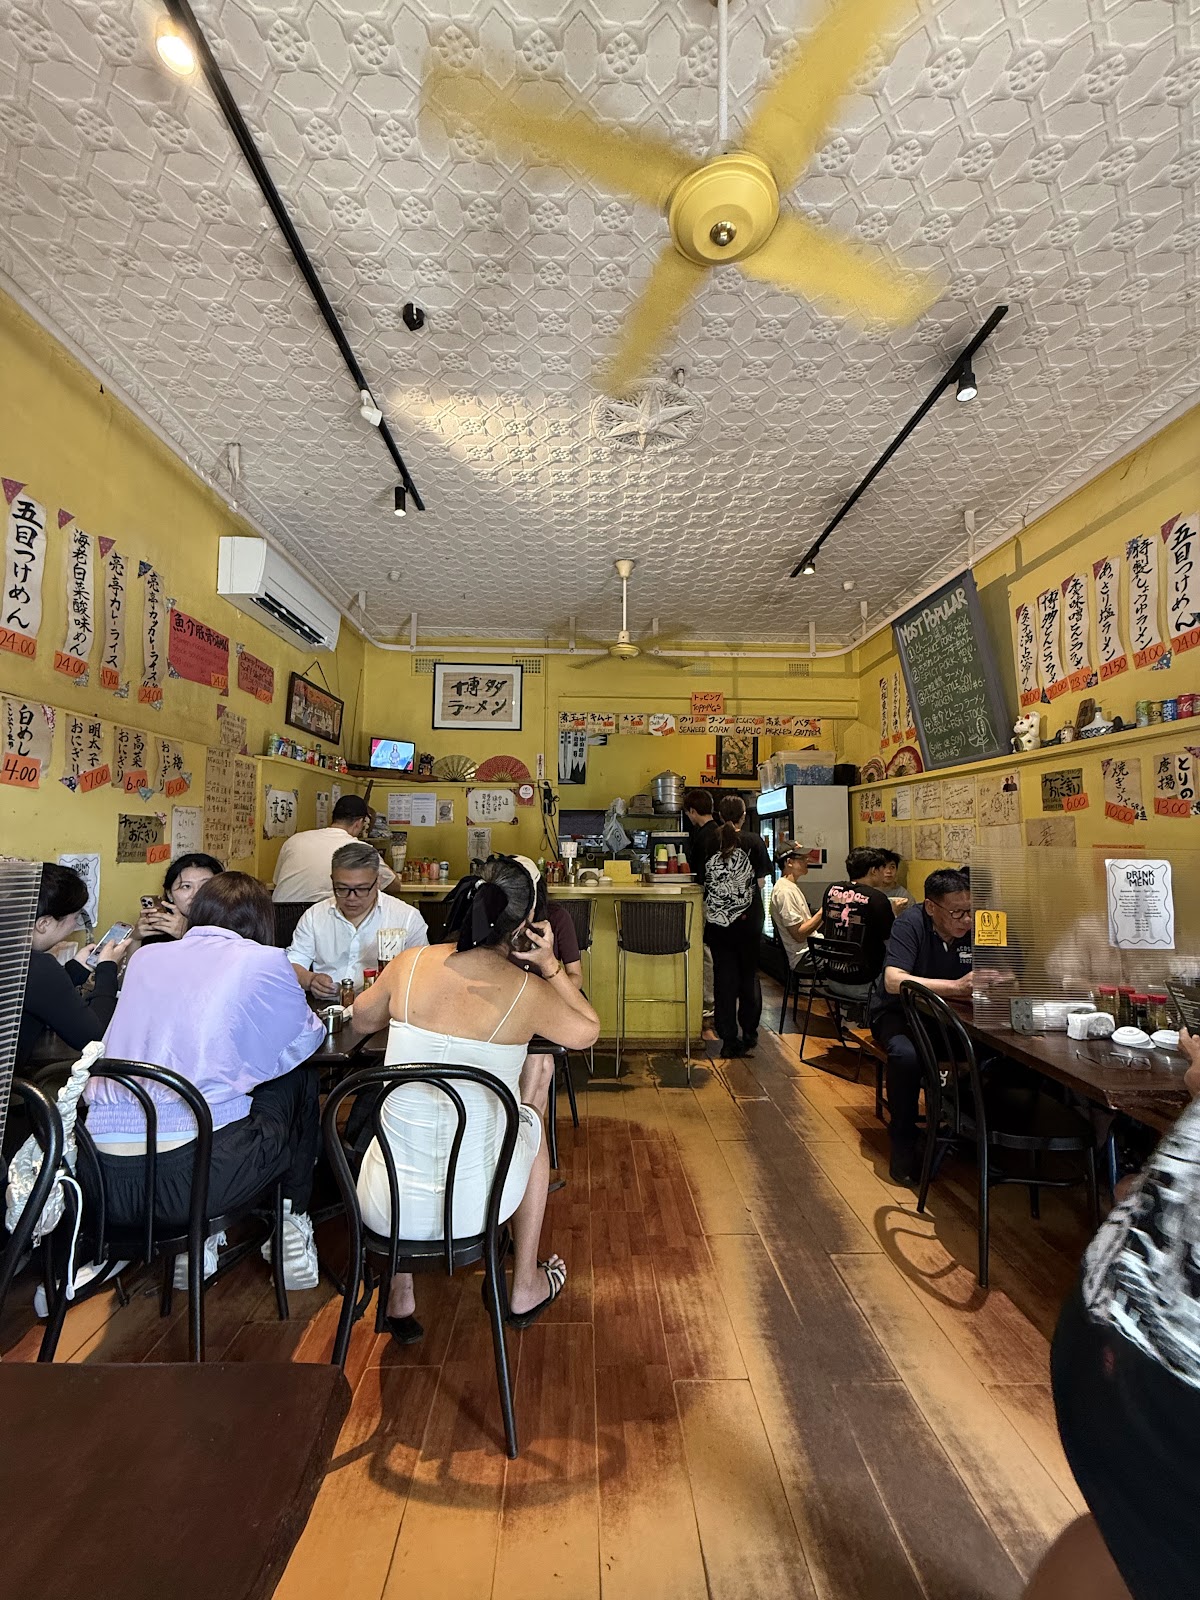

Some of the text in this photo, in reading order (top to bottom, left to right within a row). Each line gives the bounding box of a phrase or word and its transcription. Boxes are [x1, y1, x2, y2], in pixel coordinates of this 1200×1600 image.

[7, 500, 43, 629] 五目つけめん
[1170, 522, 1197, 631] 五目つけめん
[900, 588, 968, 647] MOST POPULAR
[1173, 630, 1200, 653] 24.0
[57, 653, 87, 675] 24.00
[1136, 645, 1165, 666] 24.00
[451, 676, 508, 697] 博多
[448, 699, 507, 716] ラーメン
[17, 704, 34, 757] 白めし
[679, 726, 706, 734] SEAWEED
[708, 716, 725, 724] コーン
[708, 726, 730, 734] CORN
[735, 726, 762, 735] GARLIC
[71, 719, 83, 778] おにぎり
[88, 723, 101, 767] 明太子
[132, 734, 145, 768] 高菜
[118, 730, 129, 783] おにぎり
[5, 759, 37, 783] 4.00
[85, 769, 108, 789] 7.00
[1158, 757, 1175, 790] 唐揚
[1178, 757, 1193, 799] とりの
[127, 777, 147, 791] 6.00
[1157, 800, 1188, 815] 13.00
[1126, 870, 1155, 881] DRINK
[1129, 878, 1154, 887] MENU
